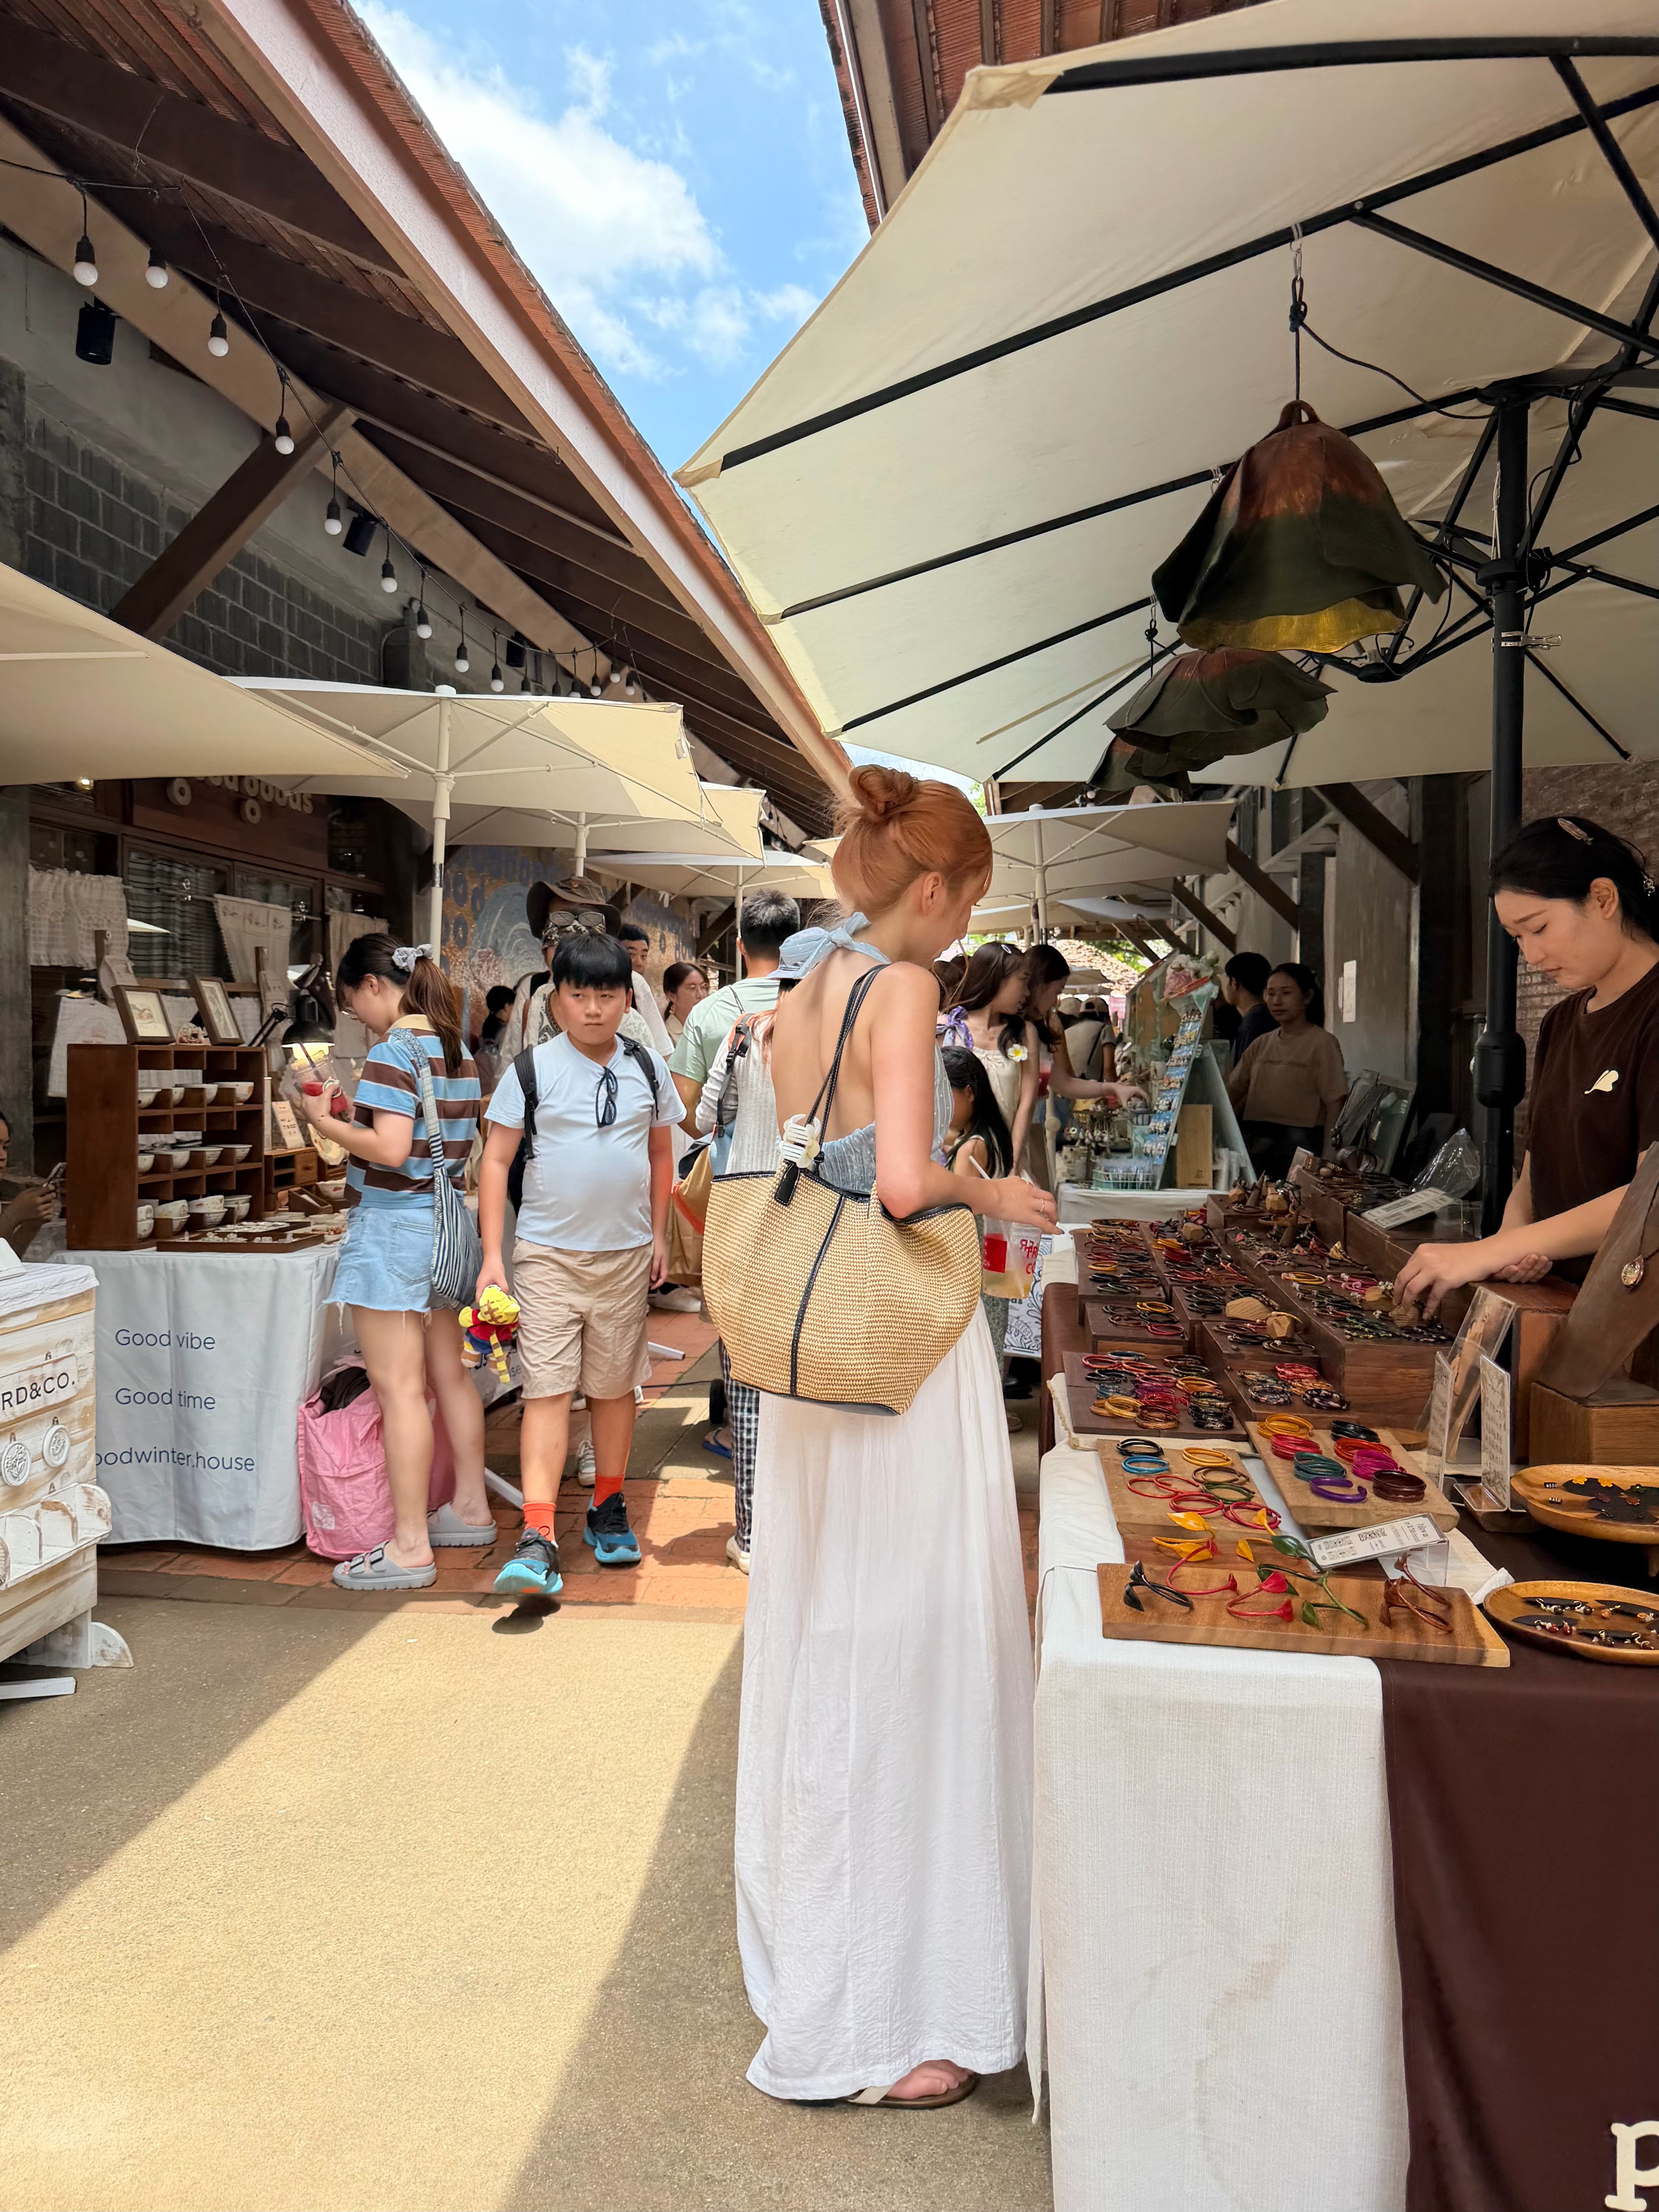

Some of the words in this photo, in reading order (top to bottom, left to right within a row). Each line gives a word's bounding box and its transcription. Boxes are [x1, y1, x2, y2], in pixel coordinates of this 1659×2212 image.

[115, 1329, 171, 1346] Good
[176, 1332, 216, 1350] vibe
[115, 1388, 172, 1405] Good
[178, 1391, 216, 1410] time
